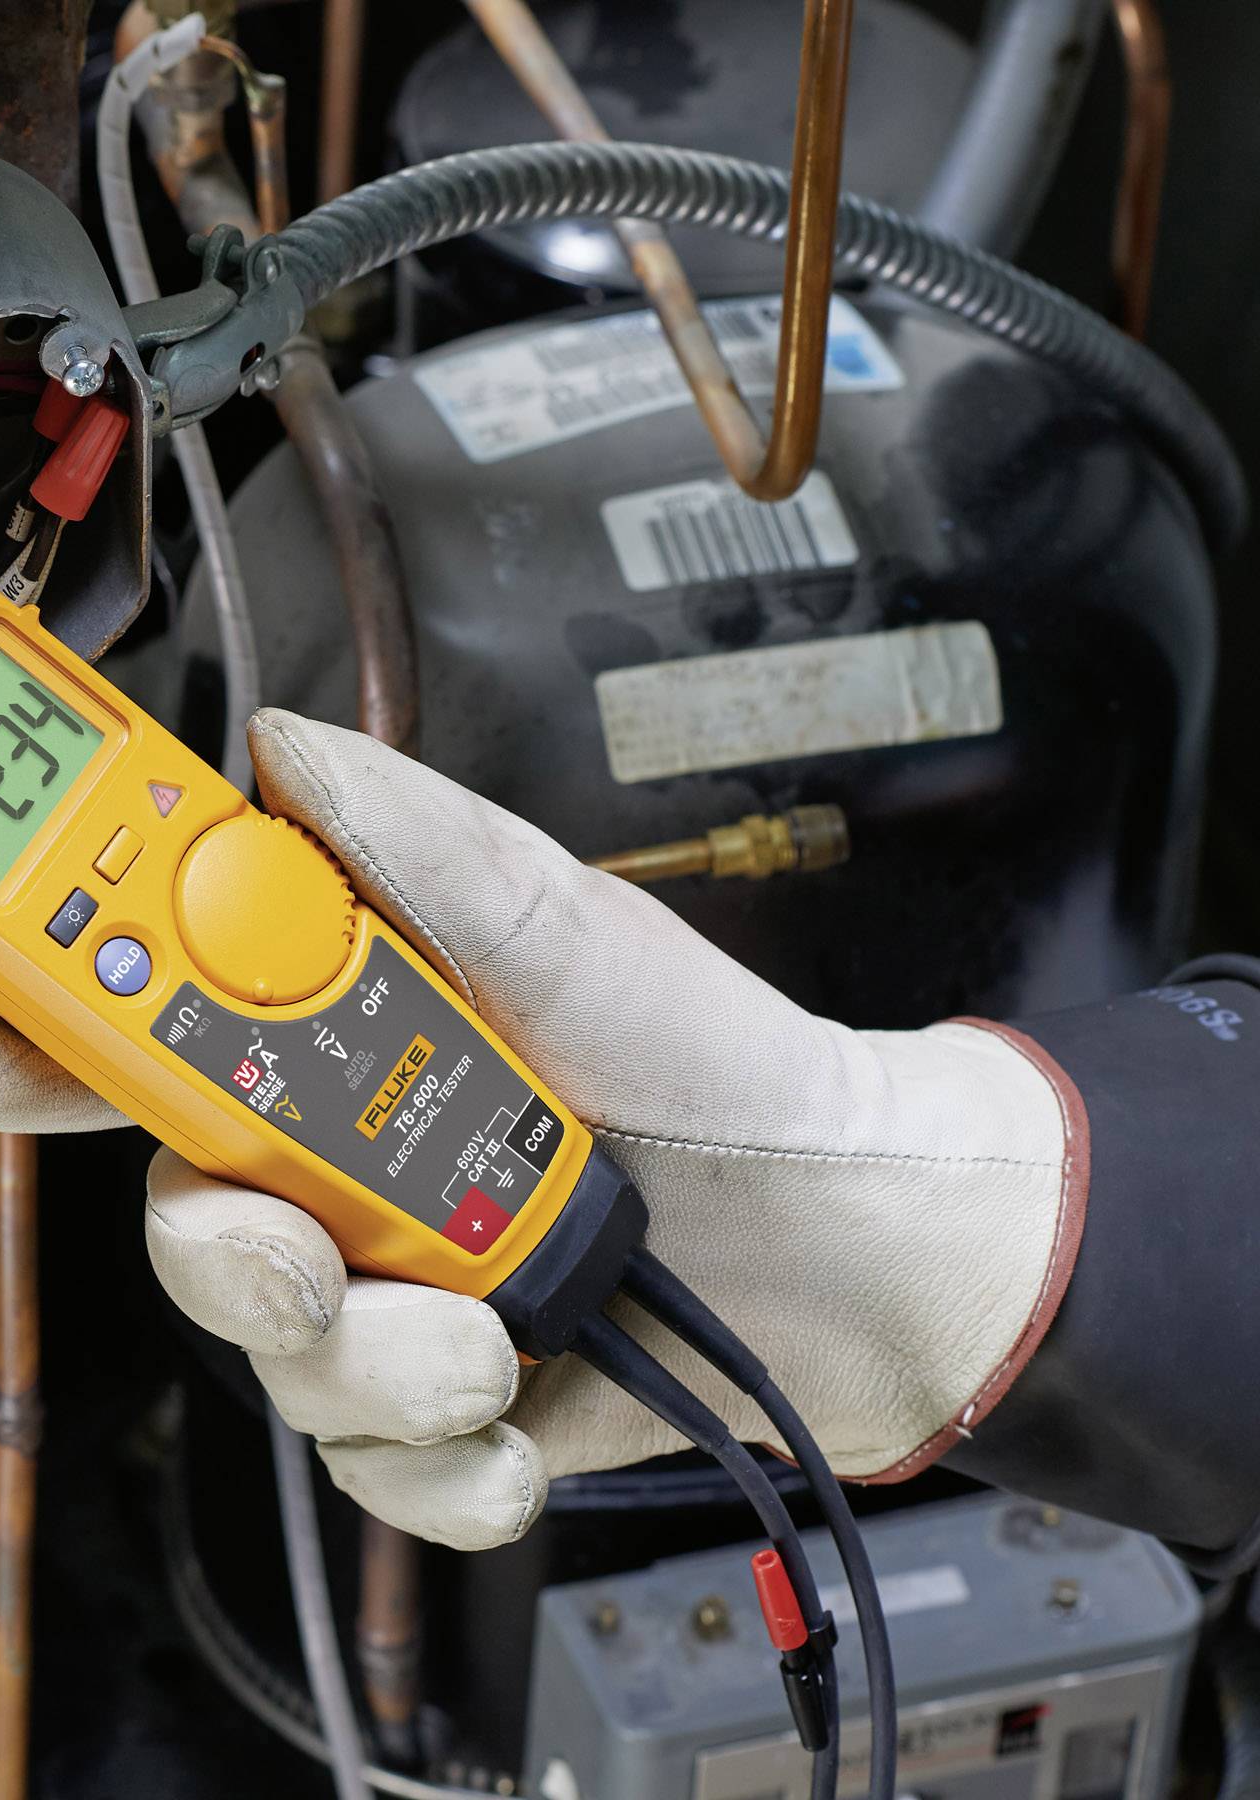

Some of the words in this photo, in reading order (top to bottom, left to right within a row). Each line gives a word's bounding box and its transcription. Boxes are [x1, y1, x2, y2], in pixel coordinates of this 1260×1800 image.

[2, 574, 25, 602] W3
[107, 945, 141, 985] HOLD
[361, 977, 391, 1017] OFF
[343, 1049, 367, 1081] AUTO
[347, 1051, 378, 1091] SELECT
[247, 1070, 277, 1108] FIELD
[257, 1079, 287, 1114] SENSE
[364, 1044, 428, 1130] FLUKE
[393, 1074, 439, 1134] T6-600
[386, 1101, 442, 1178] ELECTRICAL
[436, 1054, 474, 1103] TESTER
[524, 1114, 554, 1152] COM
[467, 1153, 490, 1183] CAT
[484, 1138, 502, 1158] III
